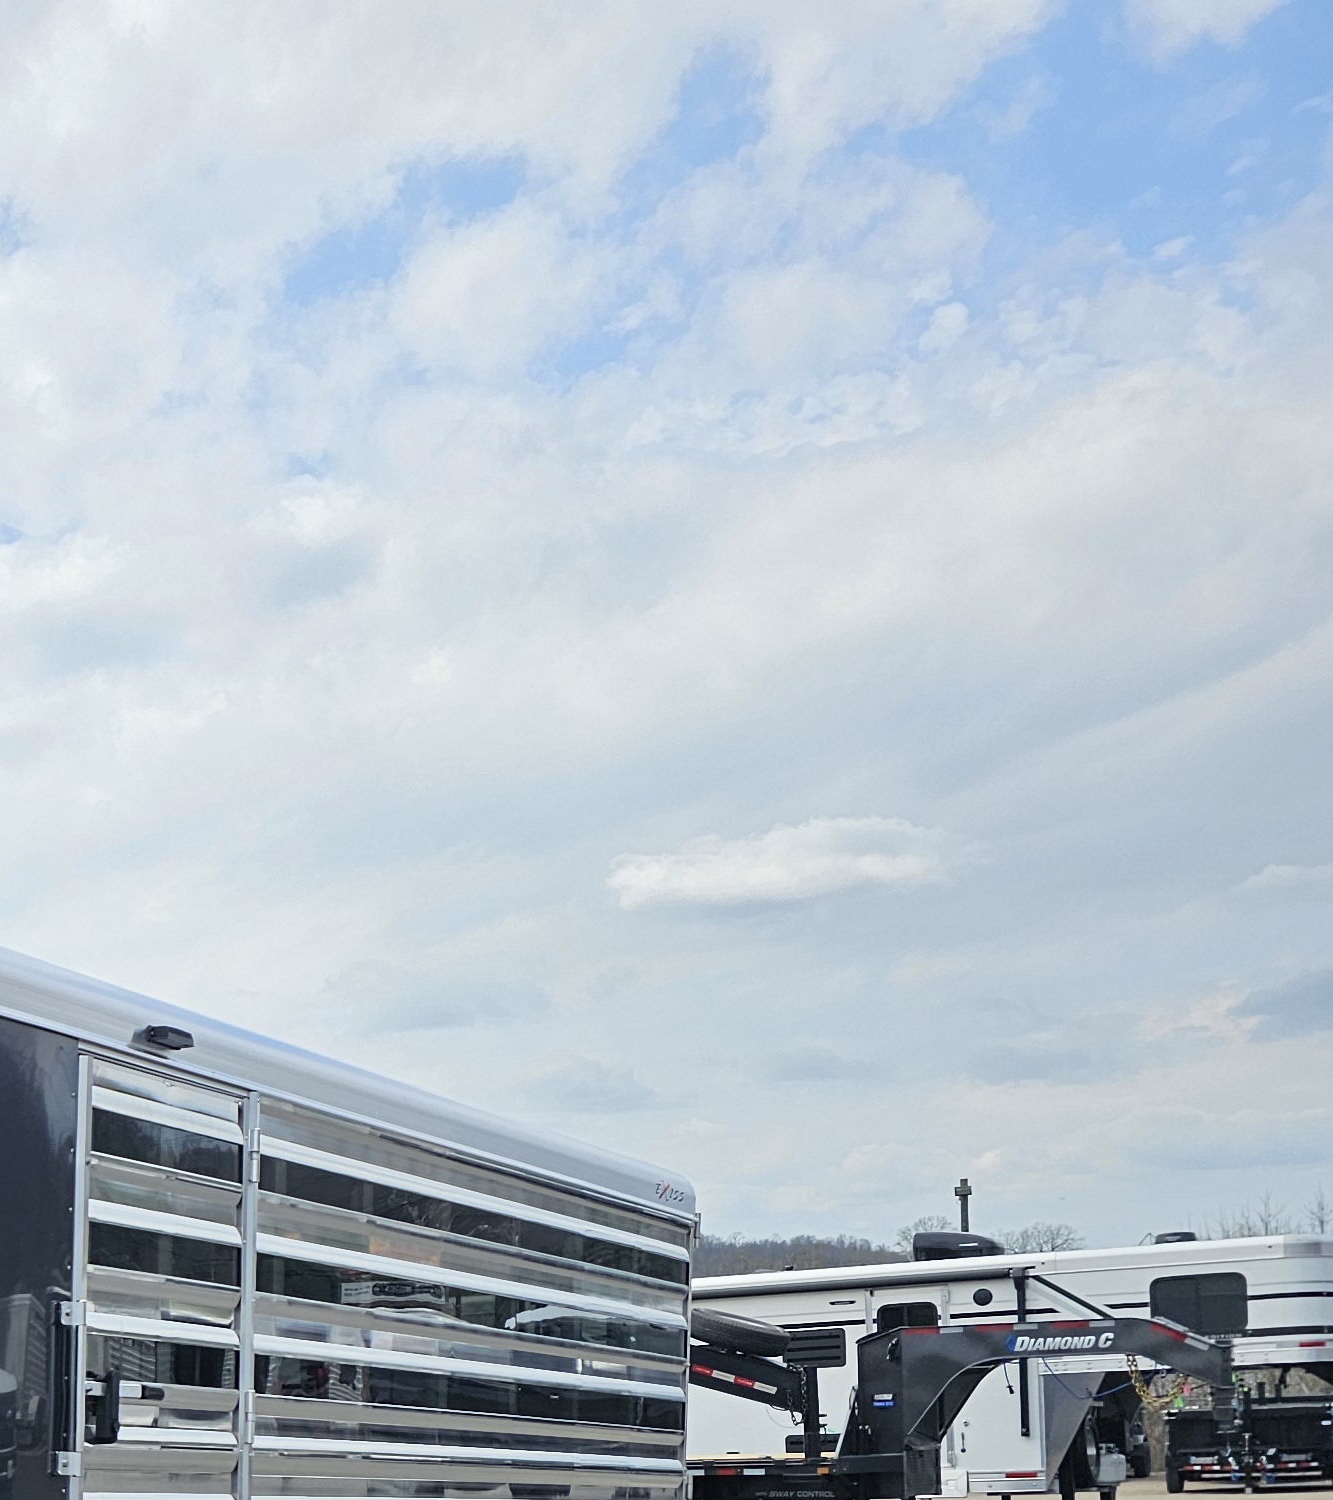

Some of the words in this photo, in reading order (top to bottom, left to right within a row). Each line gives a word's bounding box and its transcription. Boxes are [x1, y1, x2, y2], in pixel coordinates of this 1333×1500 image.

[654, 1180, 685, 1203] EXISS
[1014, 1335, 1097, 1352] DIAMOND
[1098, 1332, 1115, 1349] C
[768, 1490, 796, 1498] SWAY
[796, 1490, 836, 1498] CONTROL
